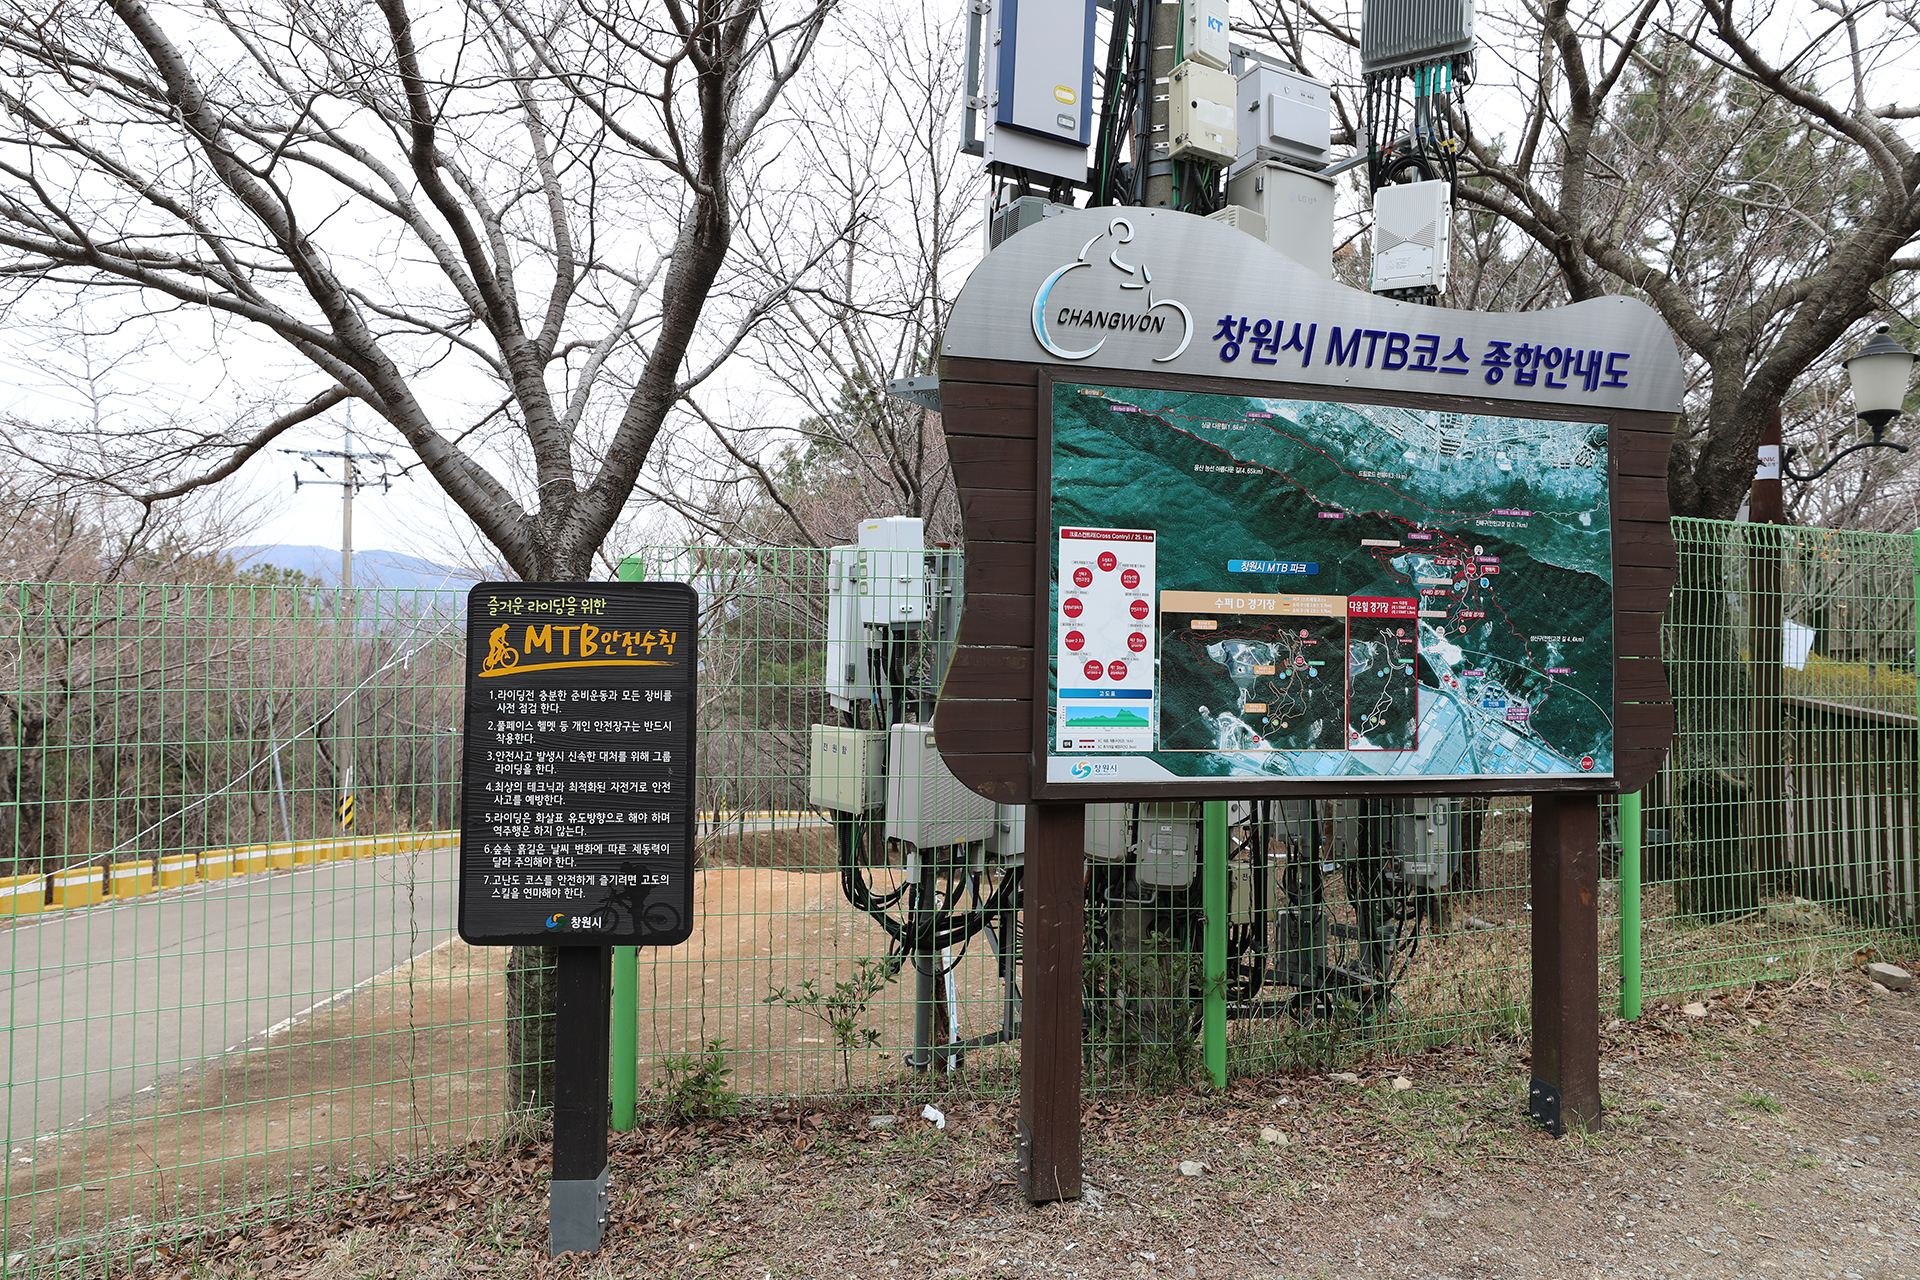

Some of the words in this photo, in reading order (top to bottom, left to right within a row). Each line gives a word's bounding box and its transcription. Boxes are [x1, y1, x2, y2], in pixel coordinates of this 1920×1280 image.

[1208, 16, 1223, 33] KT
[1057, 306, 1166, 335] CHANGWON
[1212, 315, 1317, 369] 창원시
[1326, 326, 1472, 376] MTB코스
[1481, 341, 1630, 392] 종합안내도
[1241, 562, 1267, 572] 창원시
[1267, 563, 1288, 573] MTB
[1290, 564, 1307, 573] 파크
[487, 596, 524, 616] 즐거운
[527, 596, 578, 616] 라이딩을
[581, 598, 607, 615] 위한
[1214, 598, 1233, 609] 수퍼
[1237, 598, 1245, 609] D
[1248, 598, 1276, 610] 경기장
[1349, 601, 1368, 612] 다운힐
[1370, 602, 1389, 613] 경기장
[489, 690, 535, 701] 1.라이딩전
[538, 690, 567, 701] 충분한
[571, 690, 617, 701] 준비운동과
[621, 690, 641, 701] 모든
[644, 690, 672, 701] 장비를
[497, 703, 515, 714] 사전
[519, 703, 537, 714] 점검
[540, 703, 562, 714] 한다.
[488, 721, 534, 732] 2.풀페이스
[537, 721, 556, 732] 헬멧
[559, 721, 569, 732] 등
[572, 721, 590, 732] 개인
[593, 721, 640, 732] 안전장구는
[644, 721, 672, 732] 반드시
[495, 733, 536, 744] 착용한다.
[487, 751, 533, 763] 3.안전사고
[536, 751, 564, 763] 발생시
[568, 751, 596, 763] 신속한
[599, 751, 627, 763] 대처를
[630, 751, 649, 763] 위해
[653, 751, 672, 763] 그룹
[495, 764, 532, 775] 라이딩을
[536, 764, 557, 775] 한다.
[1094, 764, 1117, 772] 창원시
[485, 782, 523, 793] 4.최상의
[527, 782, 564, 793] 테크닉과
[569, 782, 606, 793] 최적화된
[610, 782, 647, 793] 자전거로
[651, 782, 671, 793] 안전
[494, 795, 522, 806] 사고를
[525, 795, 566, 806] 예방한다.
[485, 812, 531, 824] 5.라이딩은
[535, 812, 564, 824] 화살표
[568, 812, 624, 824] 유도방향으로
[628, 812, 648, 824] 해야
[651, 812, 670, 824] 하며
[493, 826, 531, 837] 역주행은
[534, 826, 552, 837] 하지
[556, 826, 587, 837] 않는다.
[484, 843, 512, 855] 6.숲속
[517, 843, 546, 855] 흙길은
[551, 843, 569, 855] 날씨
[574, 843, 603, 855] 변화에
[608, 843, 627, 855] 따른
[632, 843, 669, 855] 제동력이
[492, 857, 511, 868] 달라
[514, 857, 552, 868] 주의해야
[555, 857, 577, 868] 한다.
[484, 875, 521, 886] 7.고난도
[525, 875, 553, 886] 코스를
[557, 875, 595, 886] 안전하게
[599, 875, 637, 886] 즐기려면
[641, 875, 669, 886] 고도의
[491, 888, 520, 899] 스킬을
[523, 888, 561, 899] 연마해야
[564, 888, 585, 899] 한다.
[571, 917, 602, 929] 창원시
